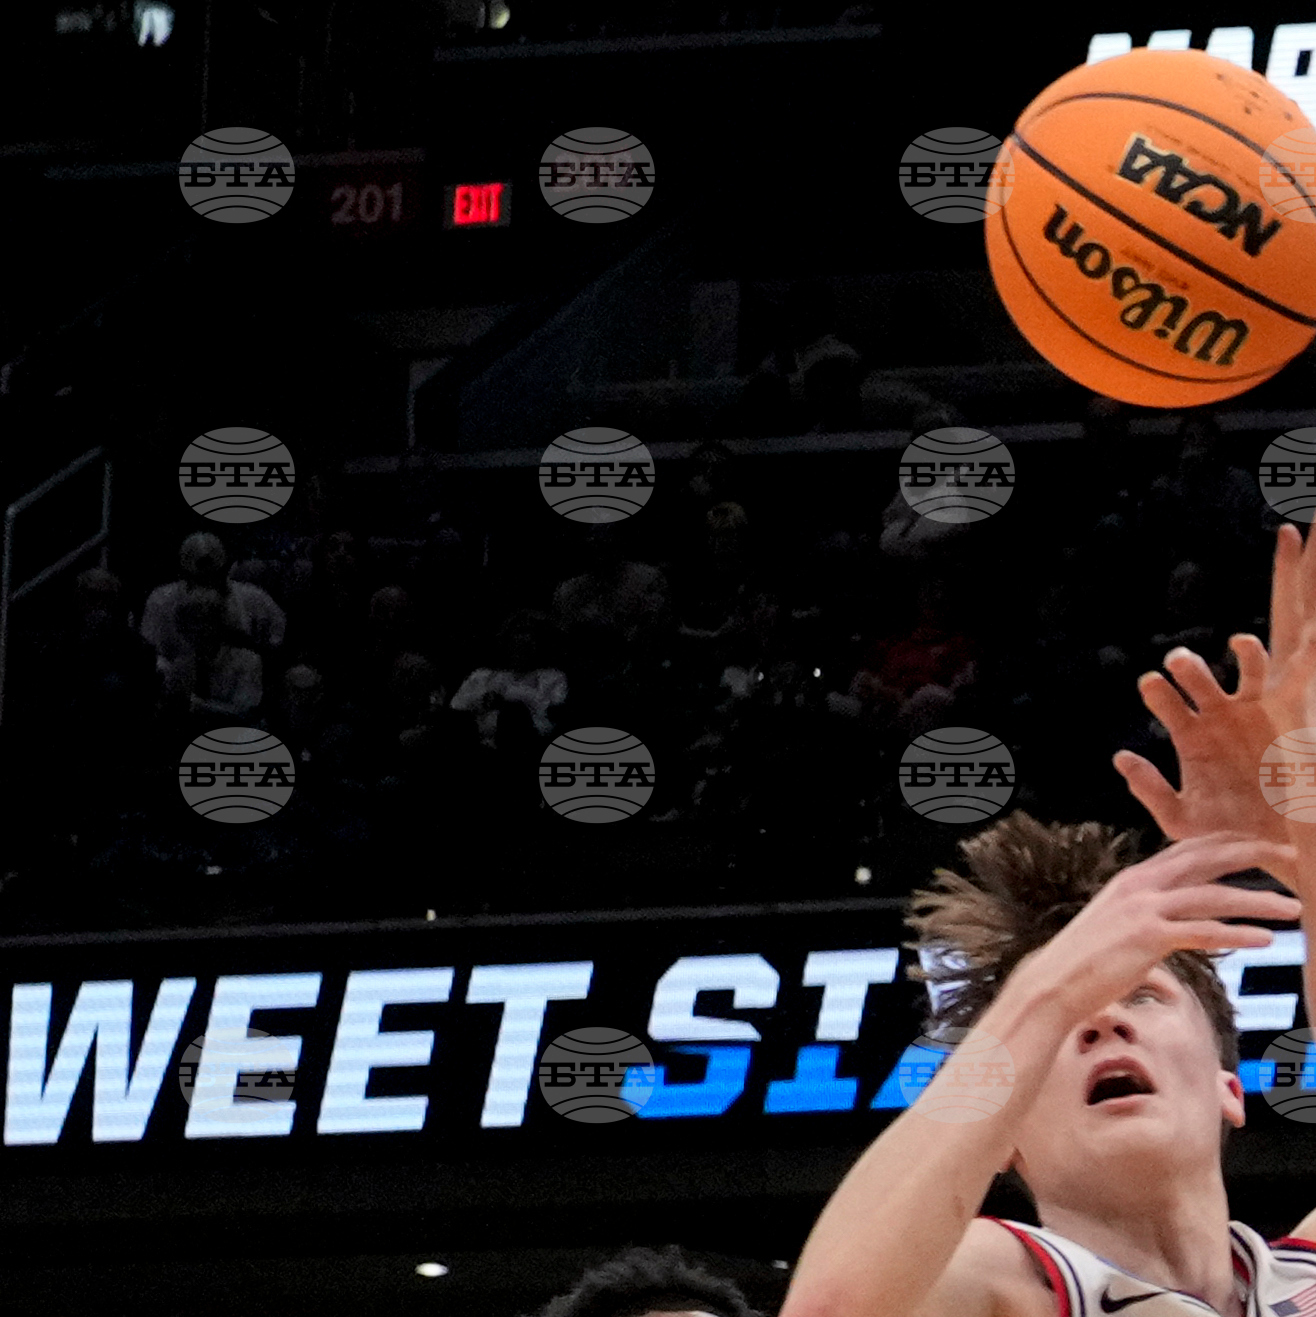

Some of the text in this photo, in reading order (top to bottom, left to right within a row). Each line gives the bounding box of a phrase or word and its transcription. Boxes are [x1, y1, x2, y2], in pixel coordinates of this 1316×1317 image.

[331, 182, 403, 225] 201
[453, 183, 503, 225] EXIT
[1117, 133, 1282, 257] NCAA
[1043, 203, 1251, 366] Wilson
